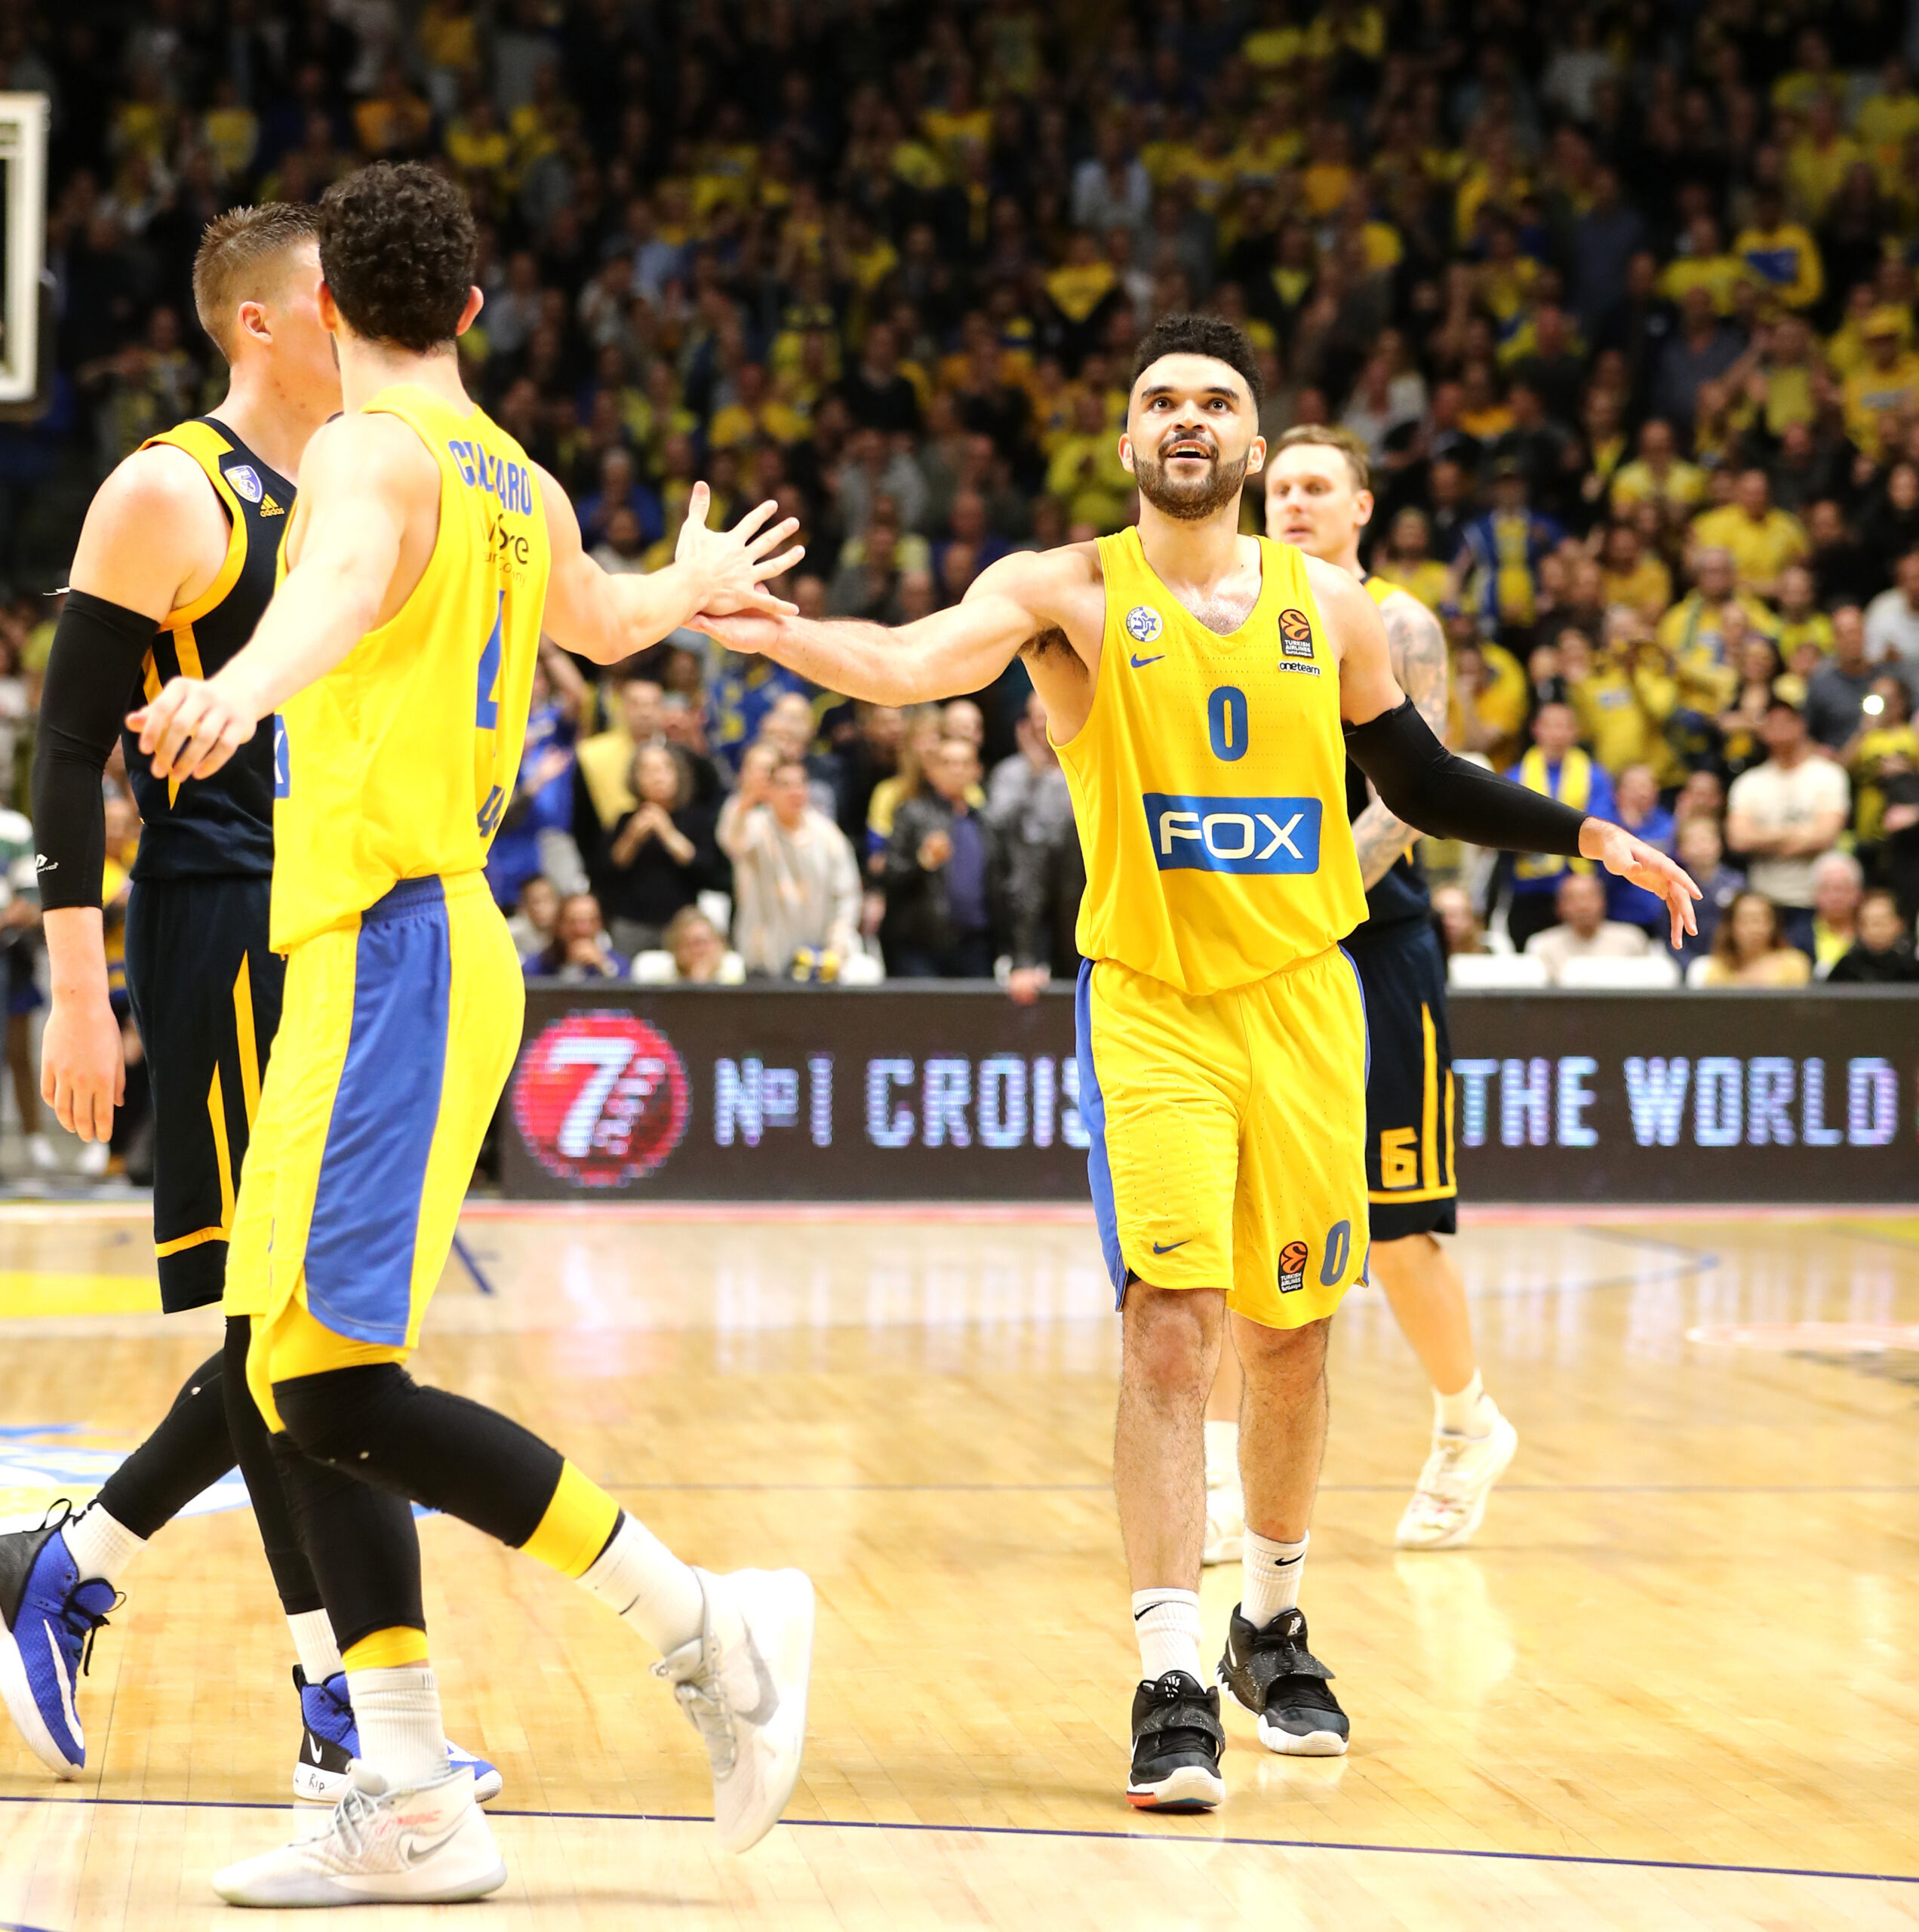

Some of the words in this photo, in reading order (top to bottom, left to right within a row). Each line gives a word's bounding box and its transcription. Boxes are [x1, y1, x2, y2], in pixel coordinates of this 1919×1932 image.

[260, 507, 284, 518] adidas
[1284, 639, 1311, 648] TURKISH
[1285, 645, 1312, 654] AIRLINES
[1207, 686, 1249, 761] 0
[1159, 811, 1305, 860] FOX
[1450, 1057, 1599, 1147] THE
[1623, 1057, 1899, 1147] WORLD
[1380, 1126, 1419, 1189] 6
[1320, 1220, 1351, 1287] 0
[1281, 1272, 1302, 1281] TURKISH
[1281, 1277, 1301, 1287] AIRLINES
